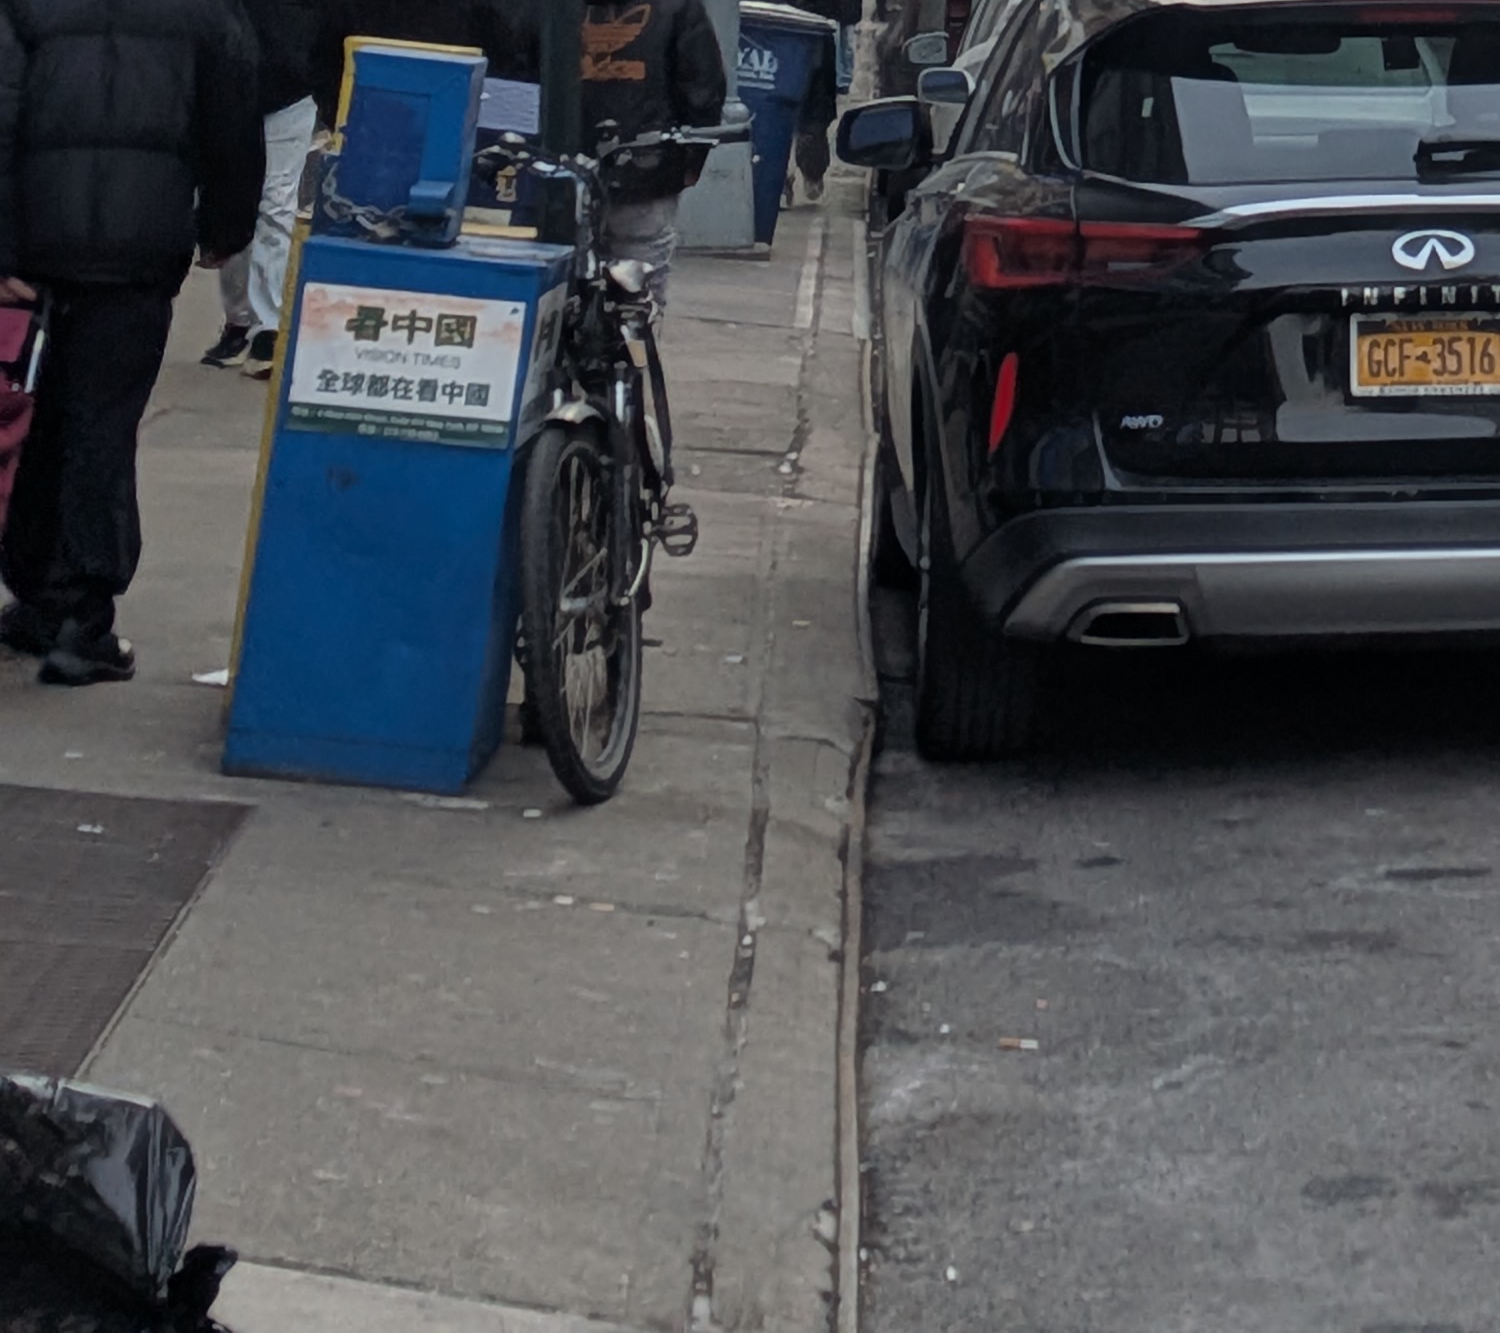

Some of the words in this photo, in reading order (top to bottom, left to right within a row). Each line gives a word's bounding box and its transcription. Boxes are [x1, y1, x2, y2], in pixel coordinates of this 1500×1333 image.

[345, 304, 478, 349] 看中國
[354, 346, 408, 366] VISION
[412, 352, 462, 370] TIMES
[316, 368, 492, 407] 全球都在看中國
[1121, 415, 1164, 429] AWD
